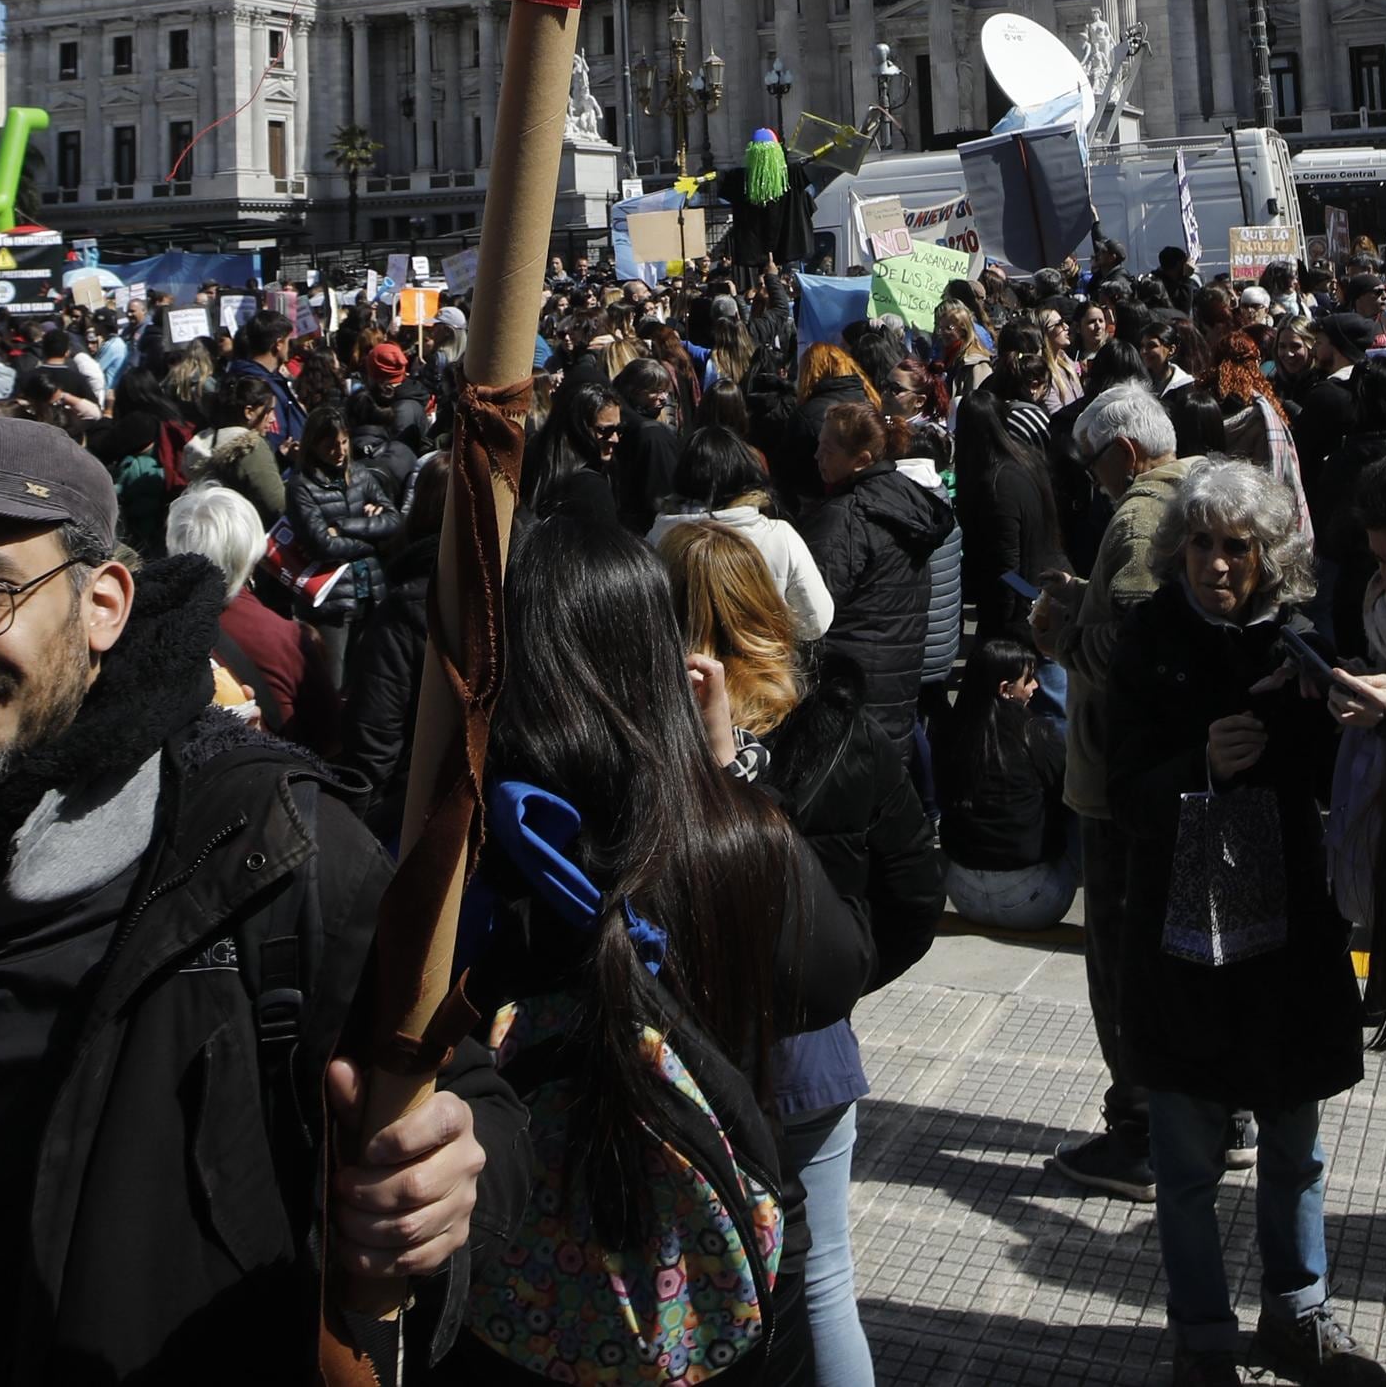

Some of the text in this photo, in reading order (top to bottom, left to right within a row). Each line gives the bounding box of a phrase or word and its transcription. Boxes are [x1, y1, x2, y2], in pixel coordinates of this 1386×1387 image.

[1303, 172, 1338, 181] Correo
[1340, 169, 1377, 179] Central
[913, 203, 955, 228] NUEVO
[1240, 229, 1289, 241] QUE LO
[871, 228, 912, 261] NO
[1234, 254, 1253, 265] NO
[876, 263, 897, 280] DE
[898, 289, 934, 311] DISCA
